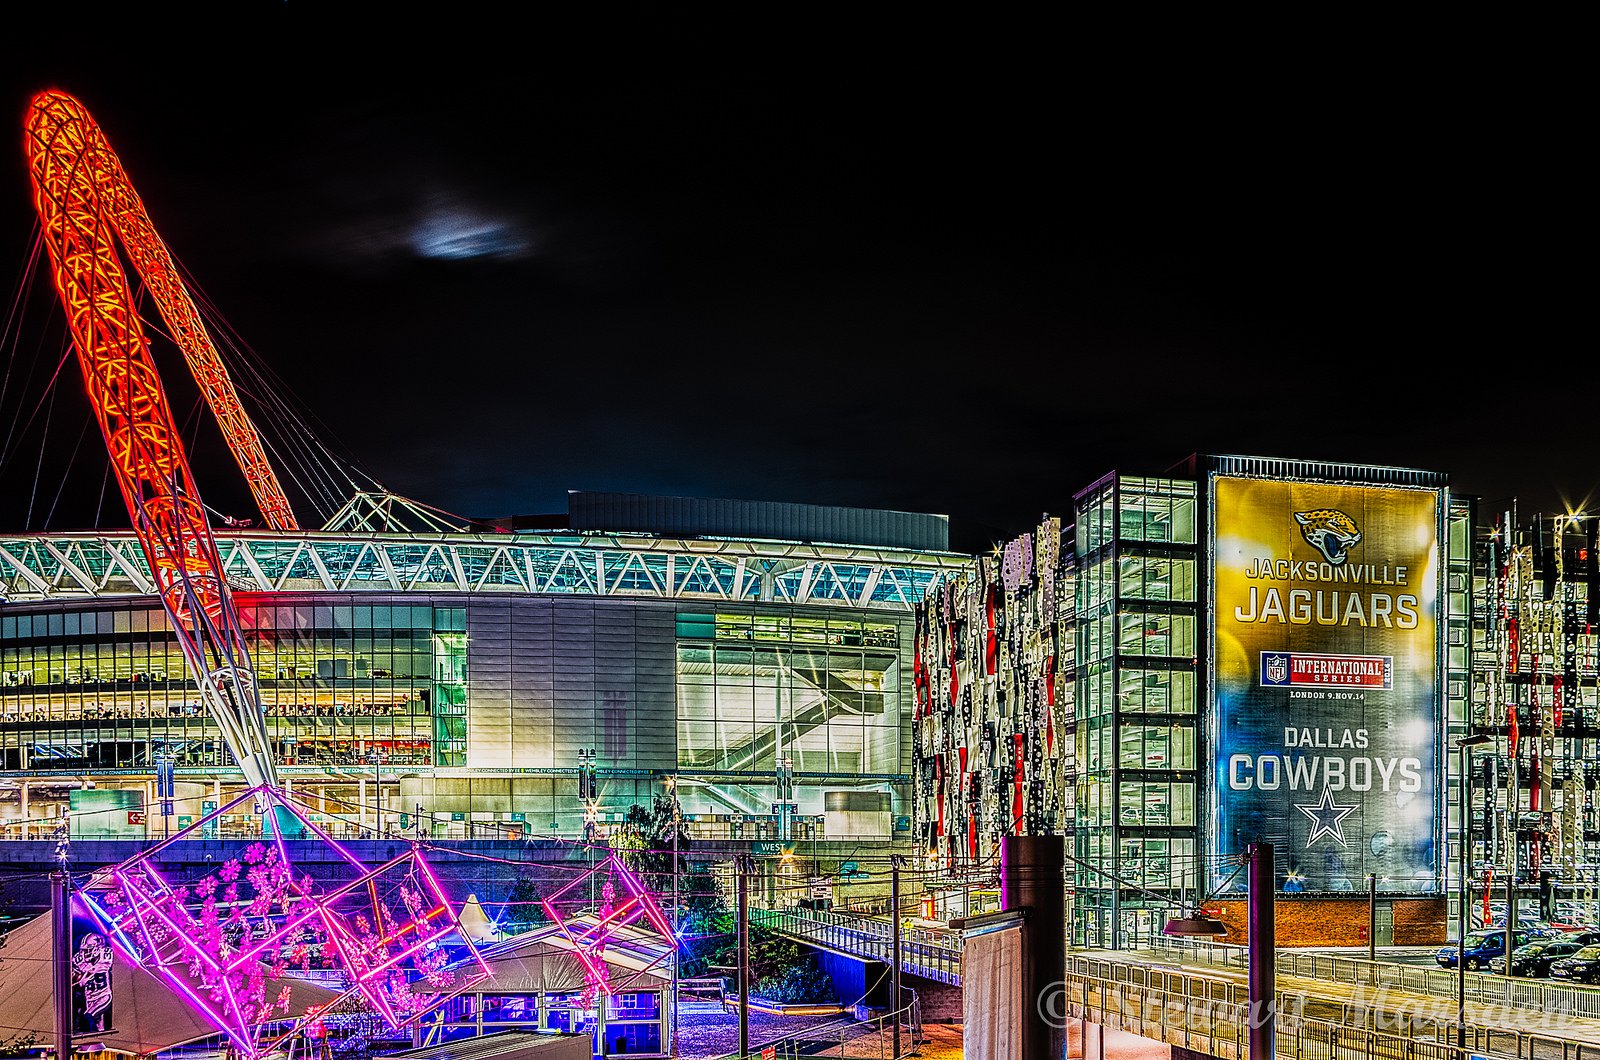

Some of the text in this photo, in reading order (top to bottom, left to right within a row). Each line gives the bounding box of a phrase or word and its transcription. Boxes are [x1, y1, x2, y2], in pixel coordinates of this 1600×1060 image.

[1246, 558, 1408, 586] JACKSONVILLE
[1235, 587, 1418, 629] JAGUARS
[1269, 666, 1284, 678] NFL
[1293, 660, 1381, 676] INTERNATIONAL
[1314, 675, 1361, 683] SERIES
[1290, 691, 1364, 700] LONDON 9.NOV.14
[1284, 727, 1369, 749] DALLAS
[1229, 753, 1422, 792] COWBOYS
[761, 843, 785, 851] WEST
